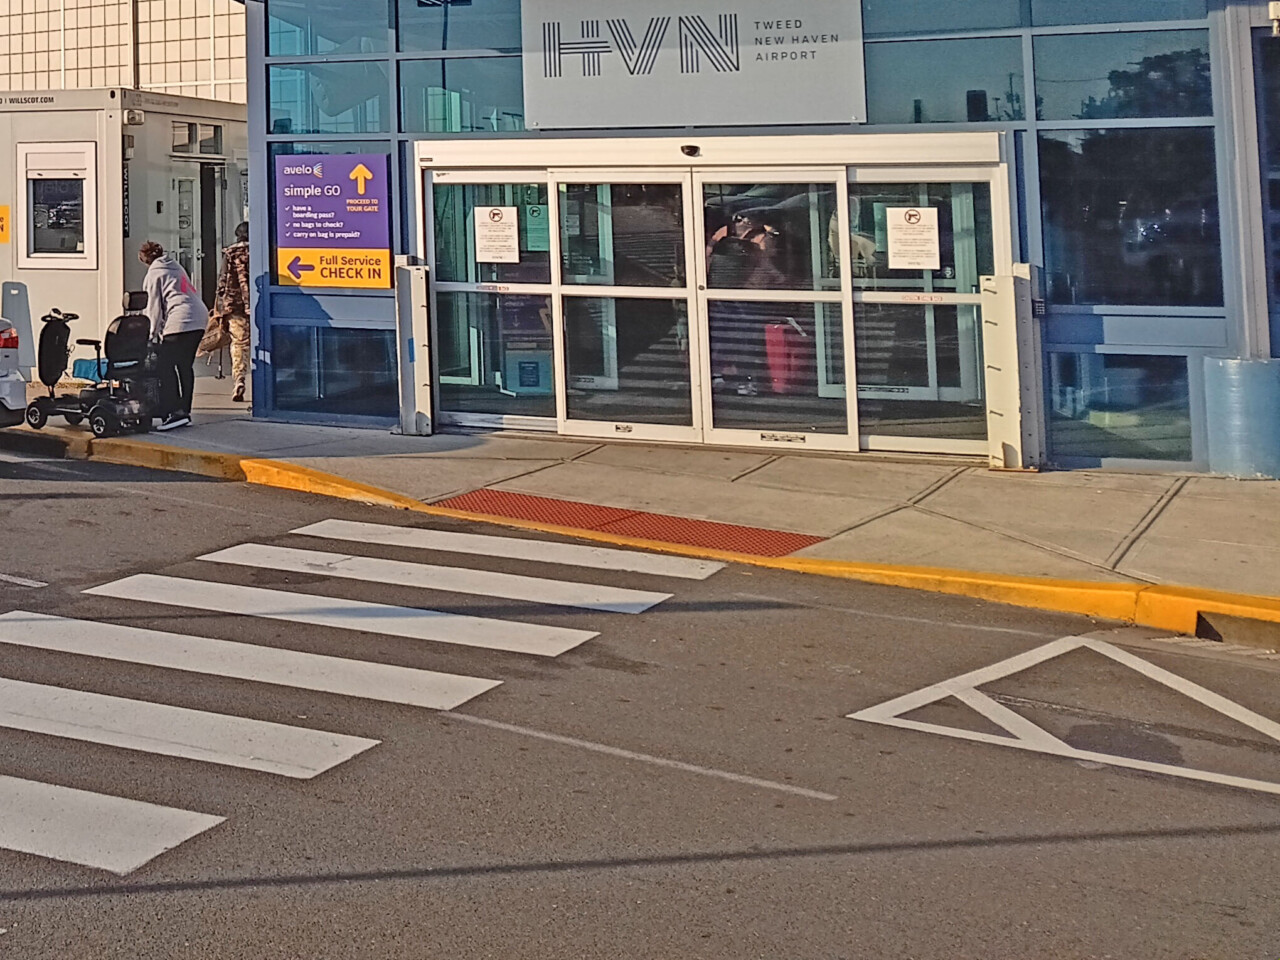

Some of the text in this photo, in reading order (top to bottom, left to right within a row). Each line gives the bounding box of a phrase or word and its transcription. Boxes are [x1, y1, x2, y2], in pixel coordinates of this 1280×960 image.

[753, 19, 802, 30] TWEED
[542, 13, 740, 78] HVN
[754, 34, 839, 46] NEW HAVEN
[756, 50, 817, 61] AIRPORT
[283, 164, 313, 175] avelo
[284, 184, 341, 198] simple GO
[301, 221, 315, 229] bags
[317, 231, 329, 239] bag
[335, 231, 361, 239] prepaid?
[319, 255, 382, 266] Full Service
[320, 267, 382, 279] CHECK IN
